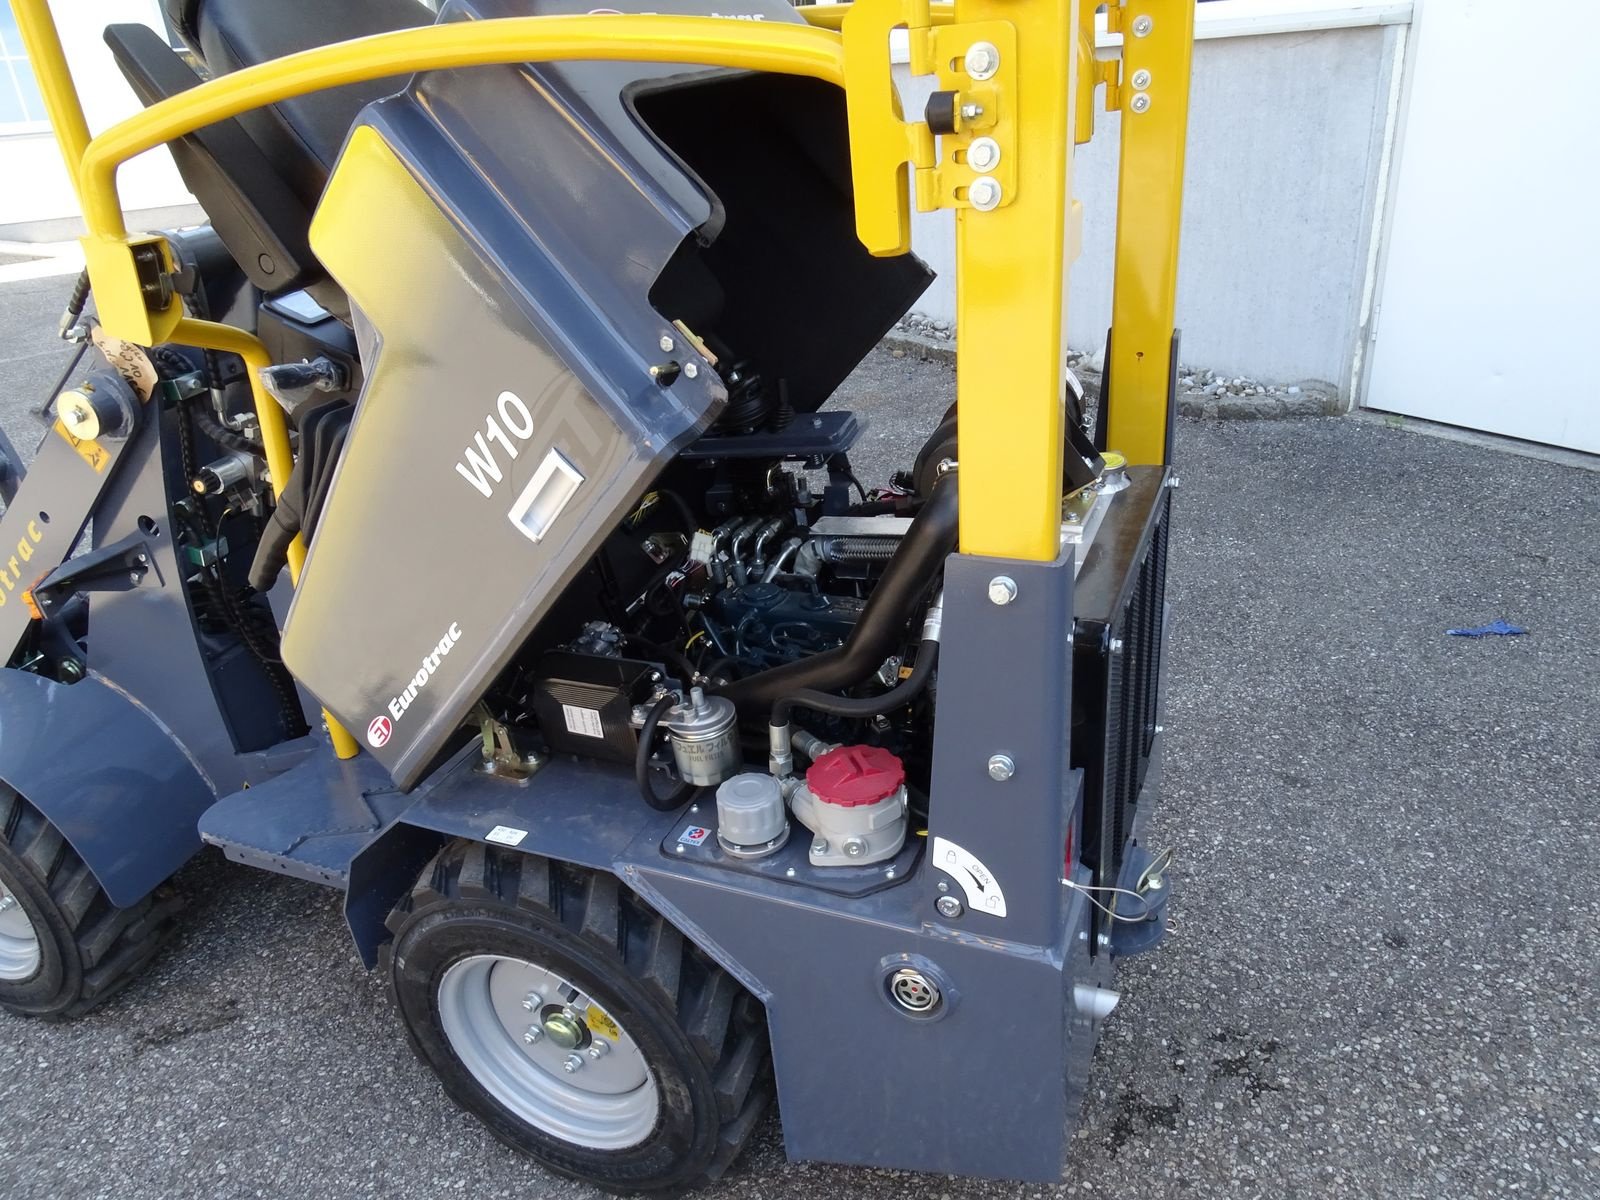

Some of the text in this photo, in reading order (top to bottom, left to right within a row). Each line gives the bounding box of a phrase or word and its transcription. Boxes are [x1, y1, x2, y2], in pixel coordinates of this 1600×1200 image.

[455, 390, 534, 499] W10
[368, 621, 463, 747] ET Eurotrac
[971, 864, 992, 885] OPEN
